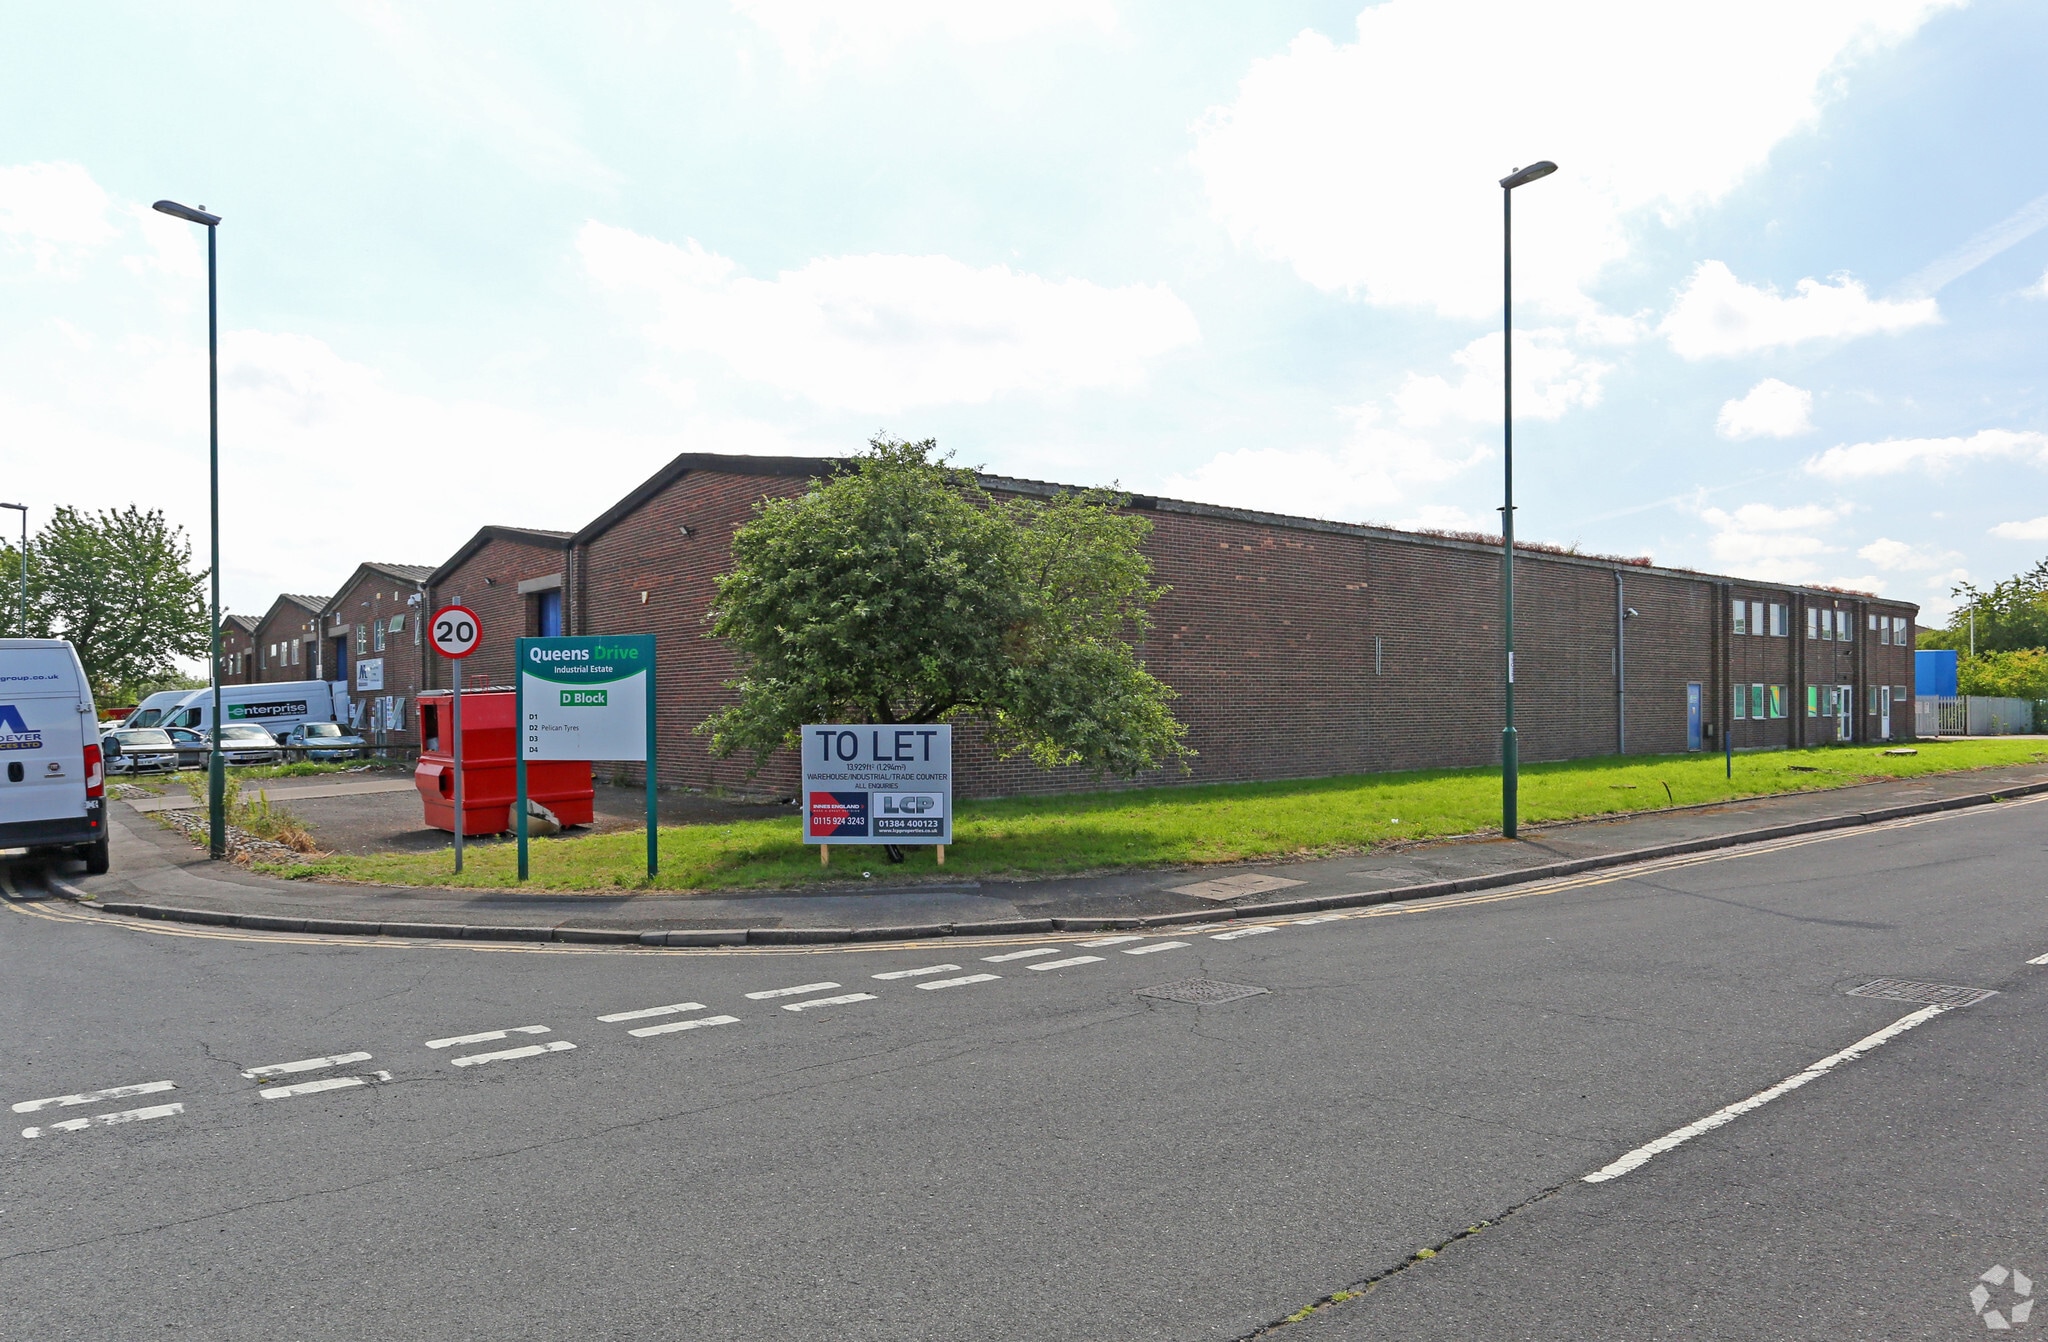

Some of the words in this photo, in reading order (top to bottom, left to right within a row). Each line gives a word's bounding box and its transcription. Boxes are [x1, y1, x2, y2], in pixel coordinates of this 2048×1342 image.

[436, 621, 474, 643] 20
[530, 647, 589, 663] Queens
[595, 645, 639, 660] Drive
[562, 694, 571, 703] D
[574, 693, 605, 703] Block
[229, 703, 306, 716] enterprise
[816, 731, 858, 761] TO
[873, 731, 937, 761] LET
[807, 773, 915, 781] WAREHOUSE/INDUSTRIAL/TRADE
[883, 796, 934, 814] LCP
[814, 817, 831, 825] 0115
[832, 817, 846, 825] 924
[847, 817, 865, 825] 3243
[879, 820, 905, 828] 01384
[907, 820, 938, 828] 400123
